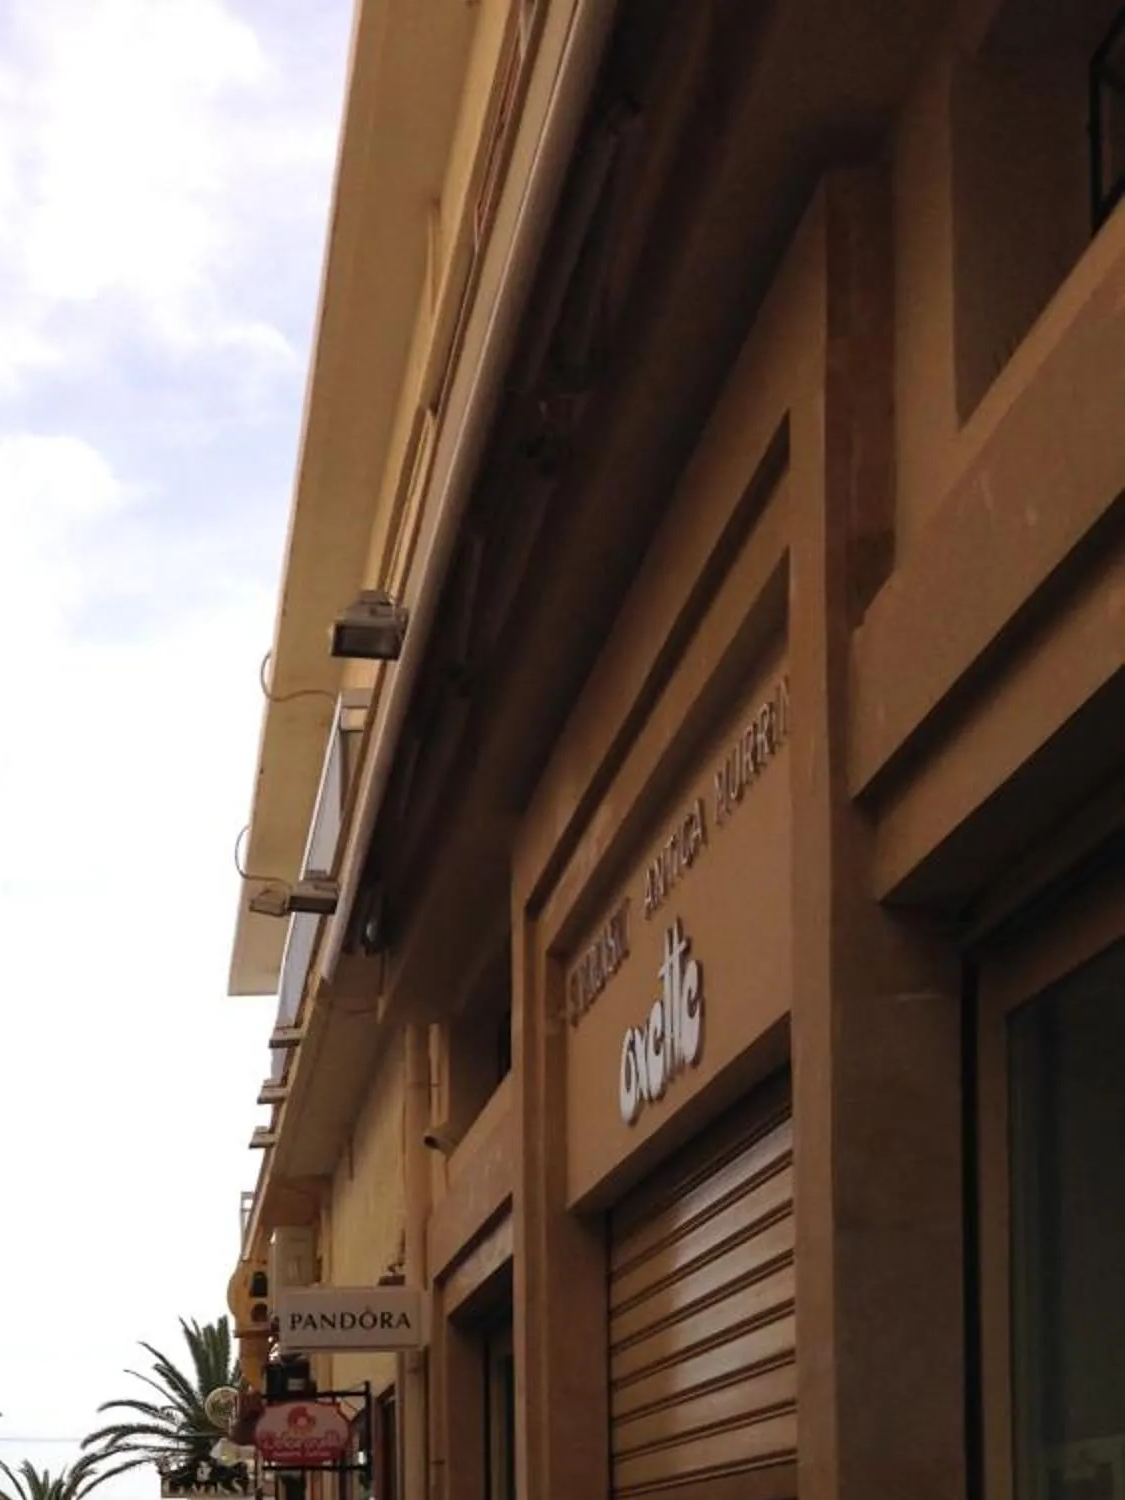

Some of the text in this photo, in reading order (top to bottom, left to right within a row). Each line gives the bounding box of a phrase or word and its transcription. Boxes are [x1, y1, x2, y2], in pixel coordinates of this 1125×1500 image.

[644, 799, 704, 911] ANTICA
[620, 918, 703, 1124] oxette
[289, 1307, 411, 1330] PANDORA
